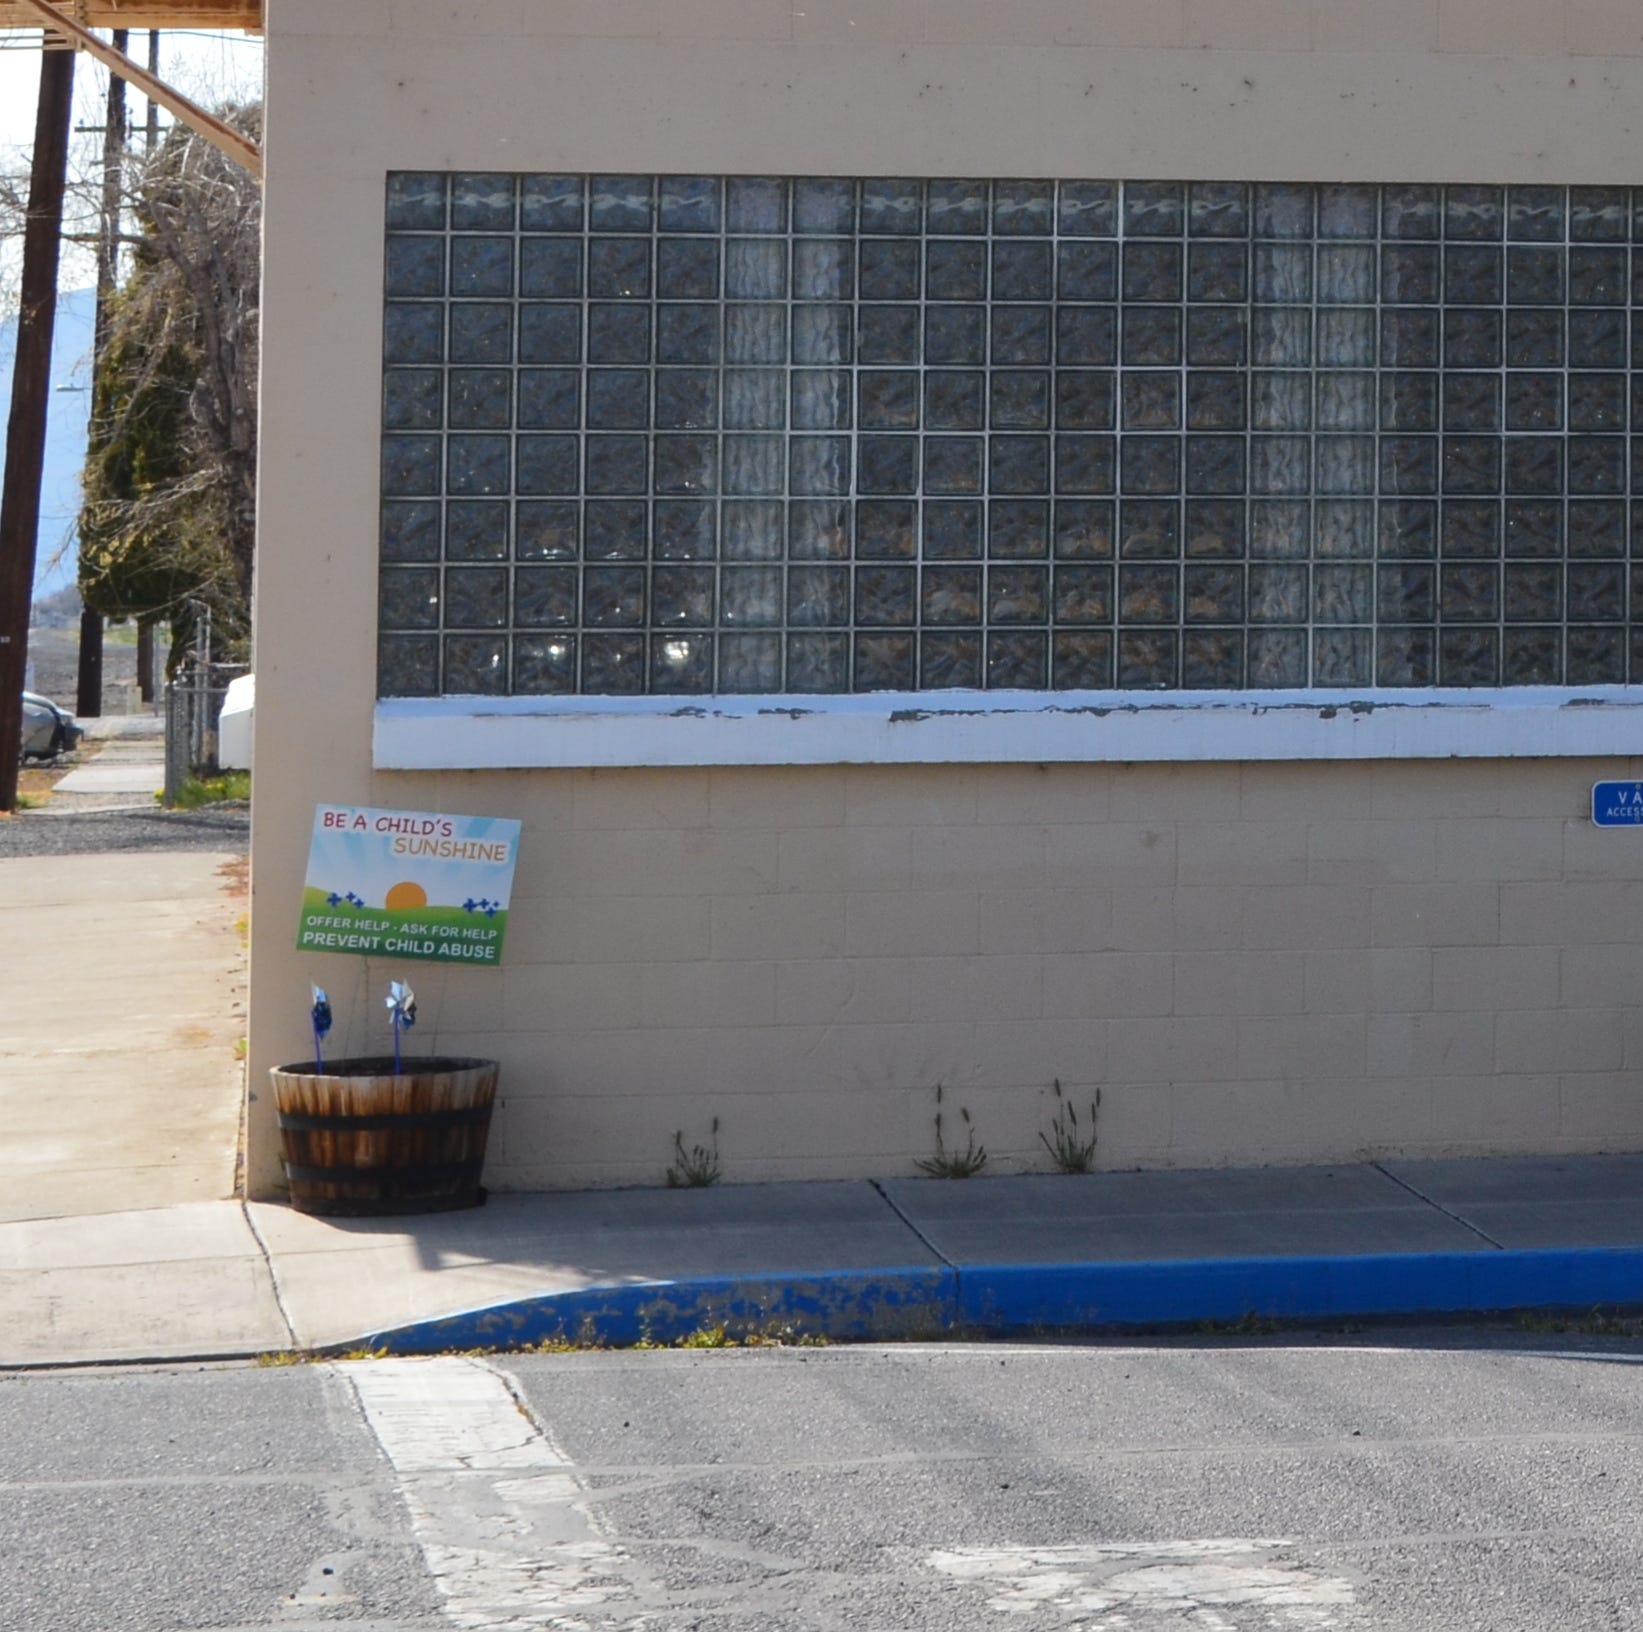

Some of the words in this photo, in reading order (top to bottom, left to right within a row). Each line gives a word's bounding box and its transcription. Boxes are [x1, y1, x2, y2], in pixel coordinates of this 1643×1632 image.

[323, 811, 347, 829] BE
[353, 815, 367, 830] A
[375, 816, 453, 837] CHILD'S
[394, 837, 507, 862] SUNSHINE
[306, 915, 351, 929] OFFER
[355, 919, 390, 932] HELP
[400, 922, 428, 935] ASK
[432, 925, 459, 938] FOR
[463, 928, 497, 940] HELP
[303, 931, 381, 950] PREVENT
[385, 938, 435, 955] CHILD
[438, 942, 496, 959] ABUSE
